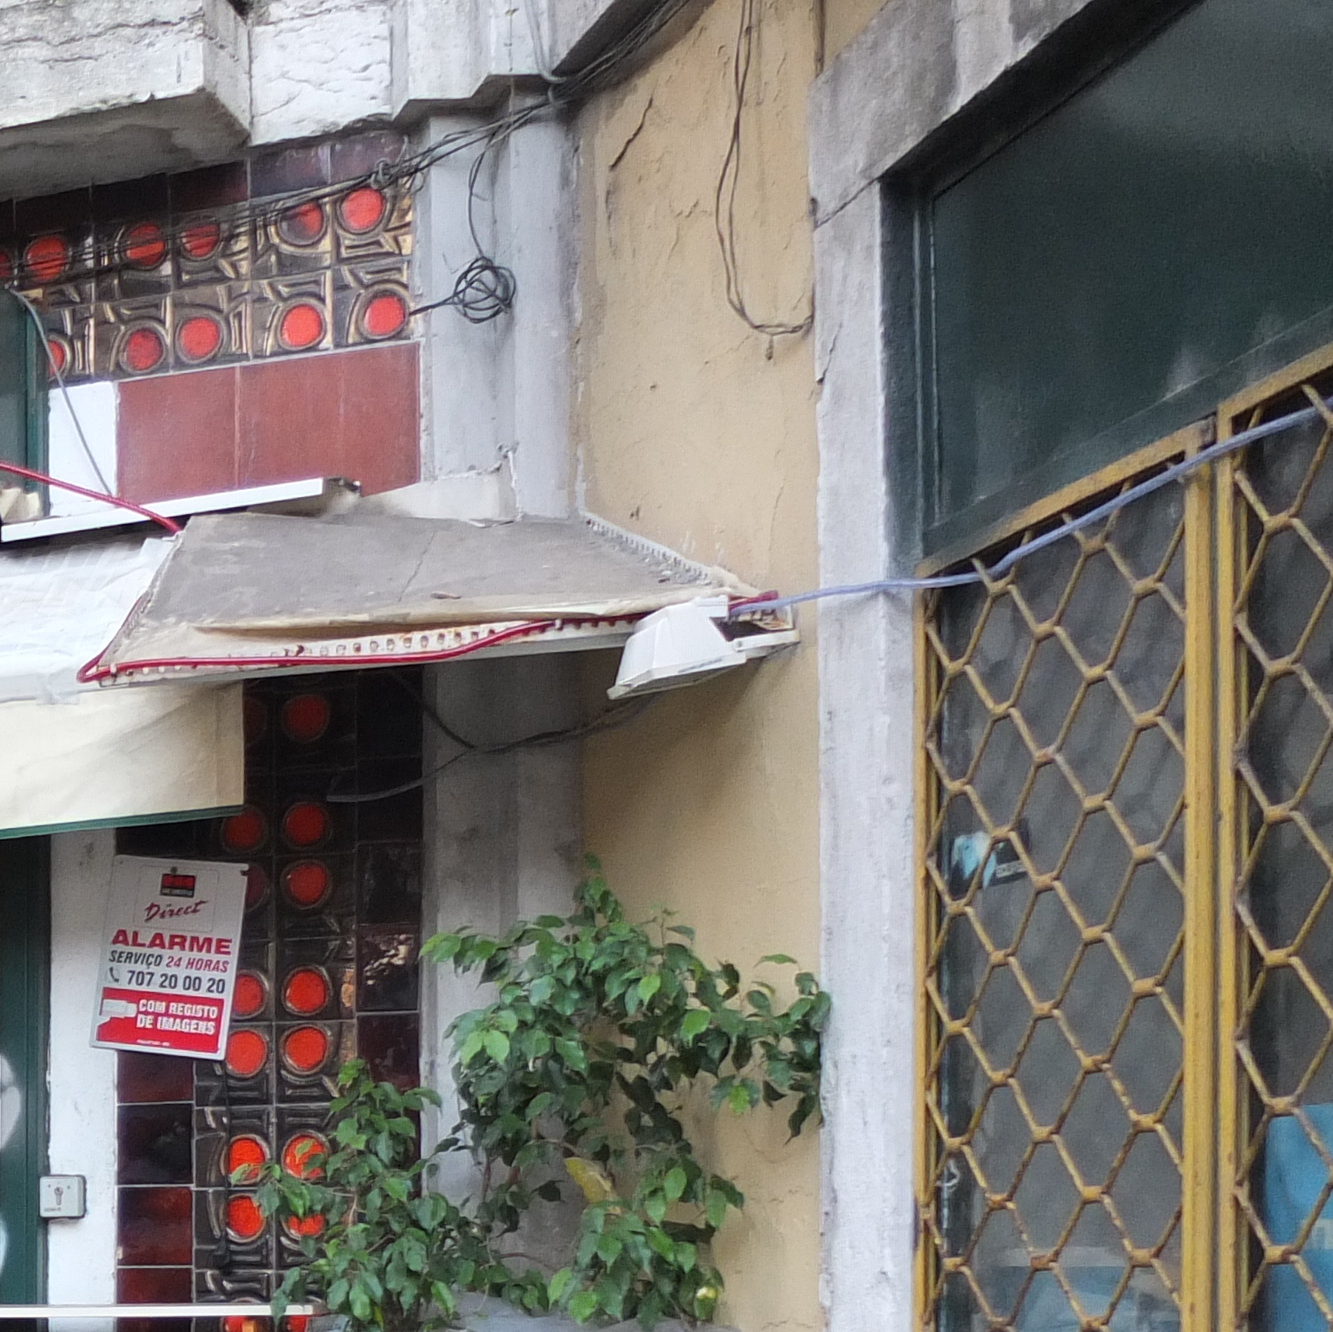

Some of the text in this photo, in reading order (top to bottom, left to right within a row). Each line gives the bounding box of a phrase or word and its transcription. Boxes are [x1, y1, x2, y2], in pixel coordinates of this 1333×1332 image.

[144, 900, 208, 923] Direct
[111, 929, 232, 955] ALARME
[108, 950, 230, 973] SERVIÇO 24 HORAS
[127, 970, 226, 994] 707 20 00 20
[138, 999, 218, 1019] COM REGISTO
[136, 1014, 215, 1035] DE IMAGENS
